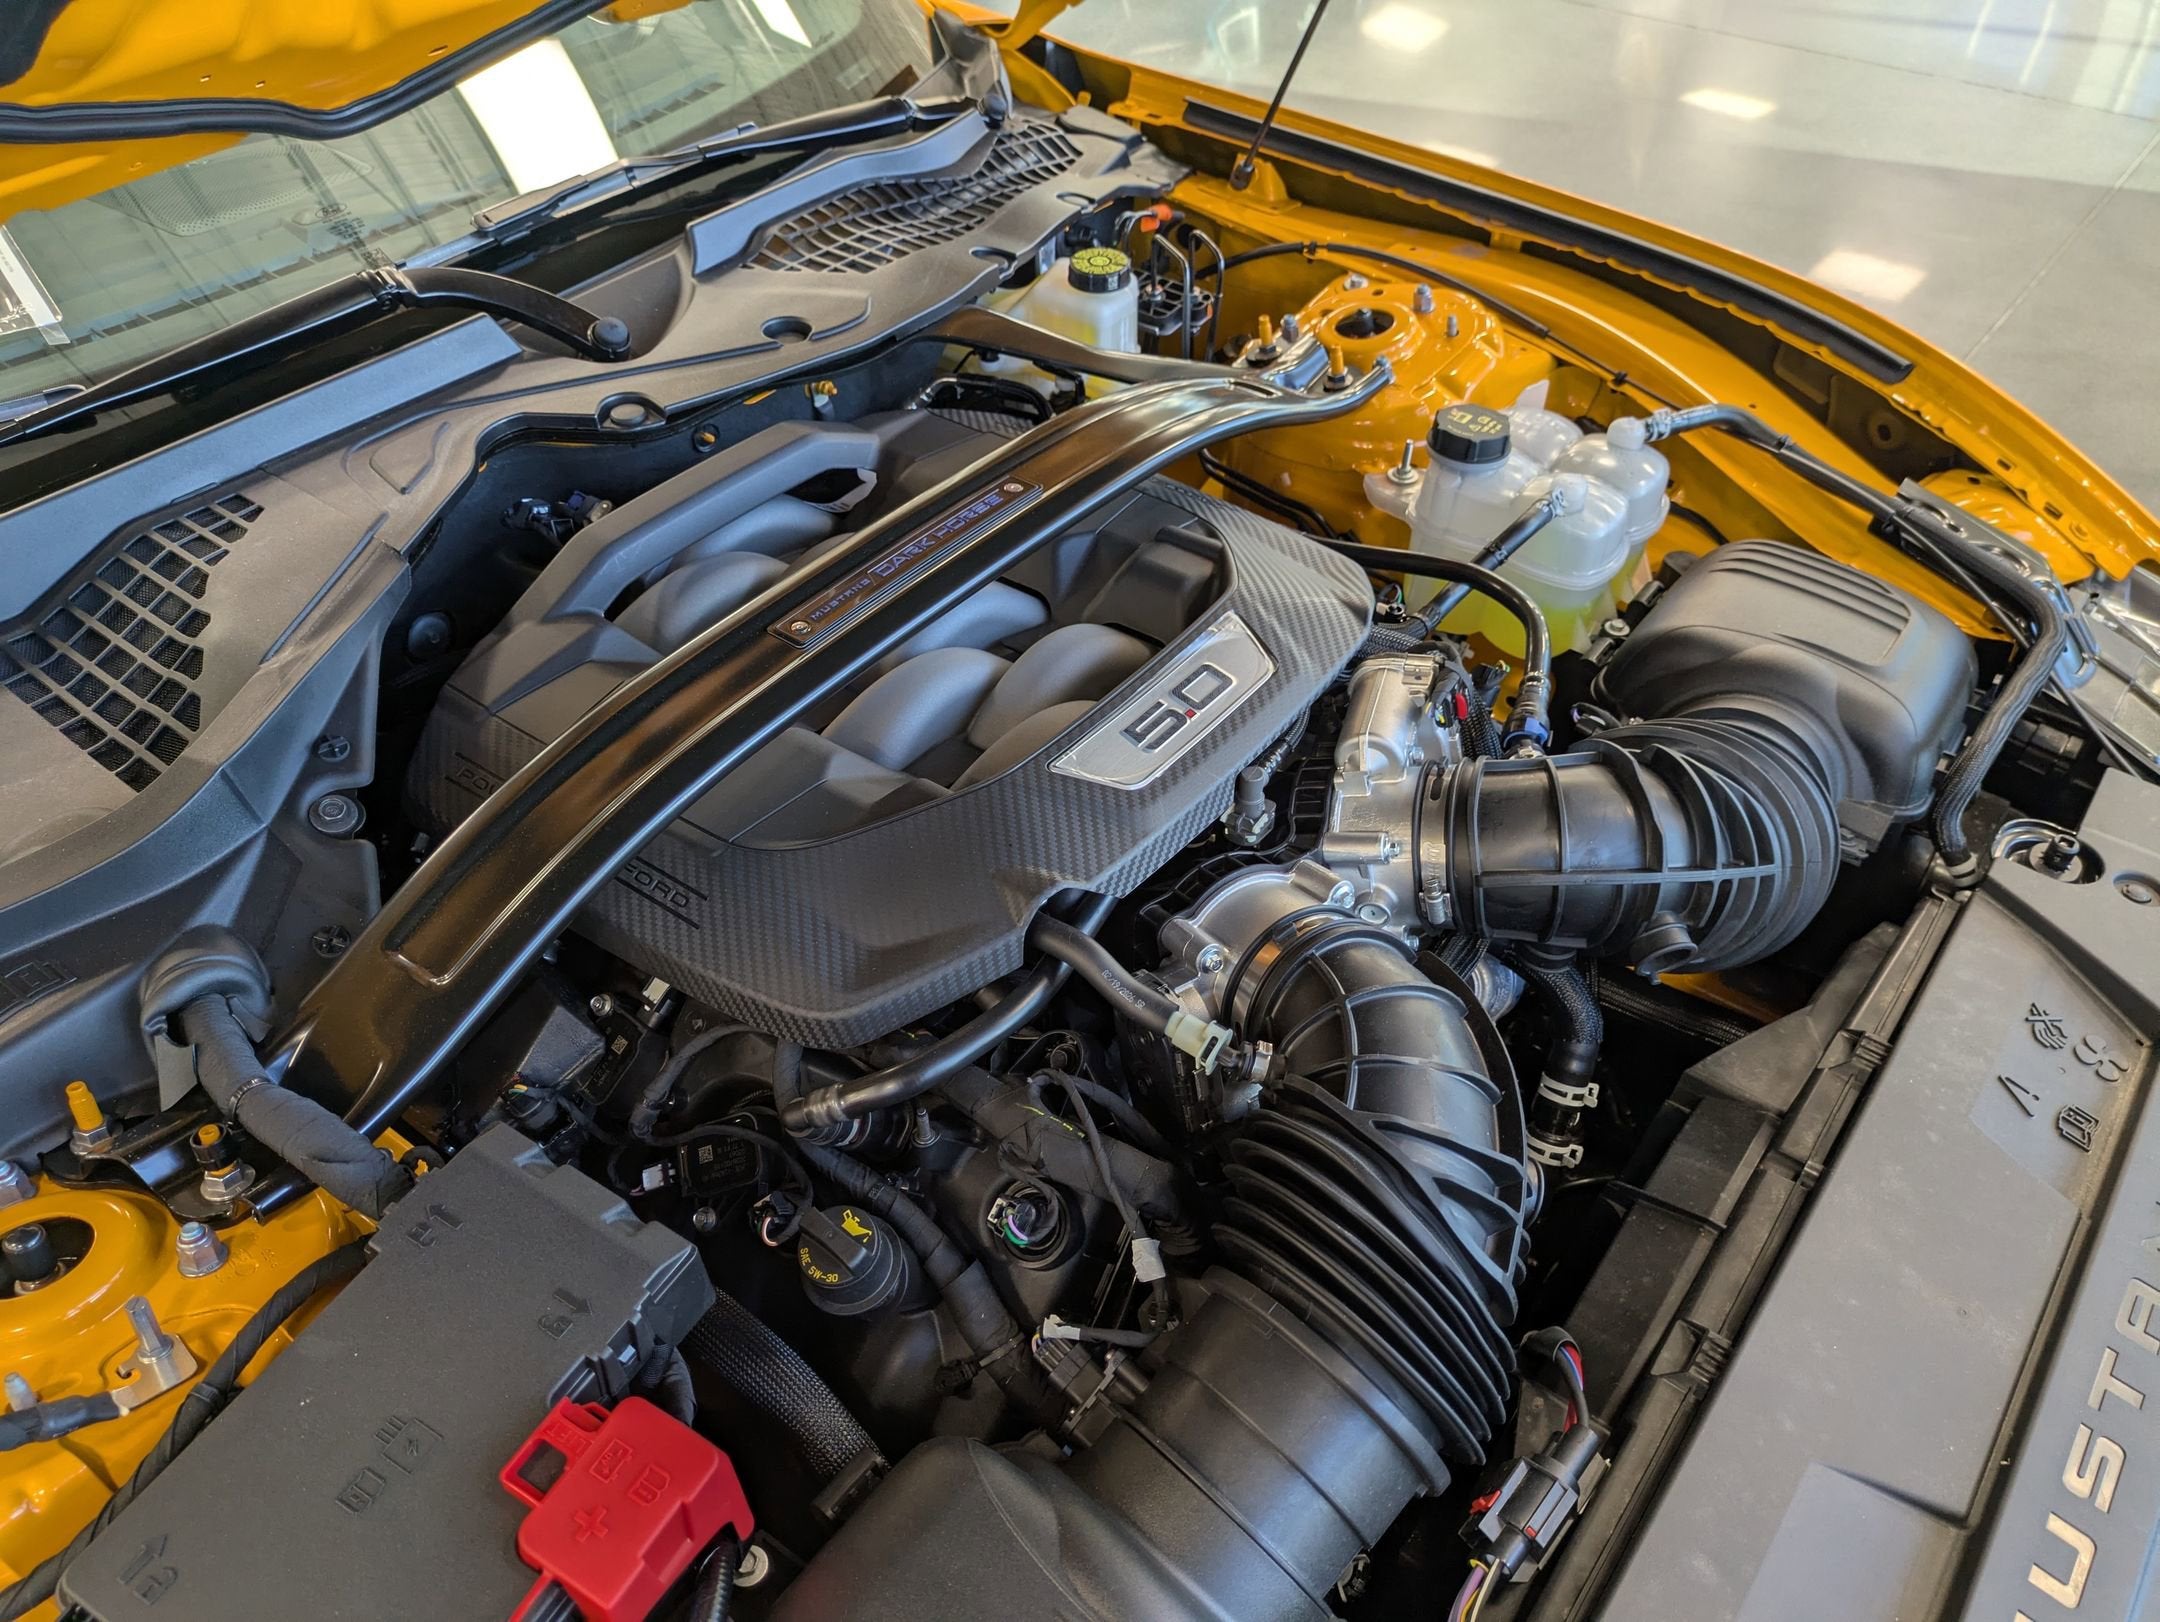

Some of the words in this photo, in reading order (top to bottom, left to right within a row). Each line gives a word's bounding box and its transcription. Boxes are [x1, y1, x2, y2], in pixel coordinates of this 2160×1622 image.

[811, 578, 871, 621] MUSTANG
[874, 538, 935, 577] DARK
[934, 494, 1003, 538] HORSE
[1121, 664, 1237, 752] 5.0
[800, 1247, 811, 1266] SAE
[808, 1265, 839, 1283] 5W-30
